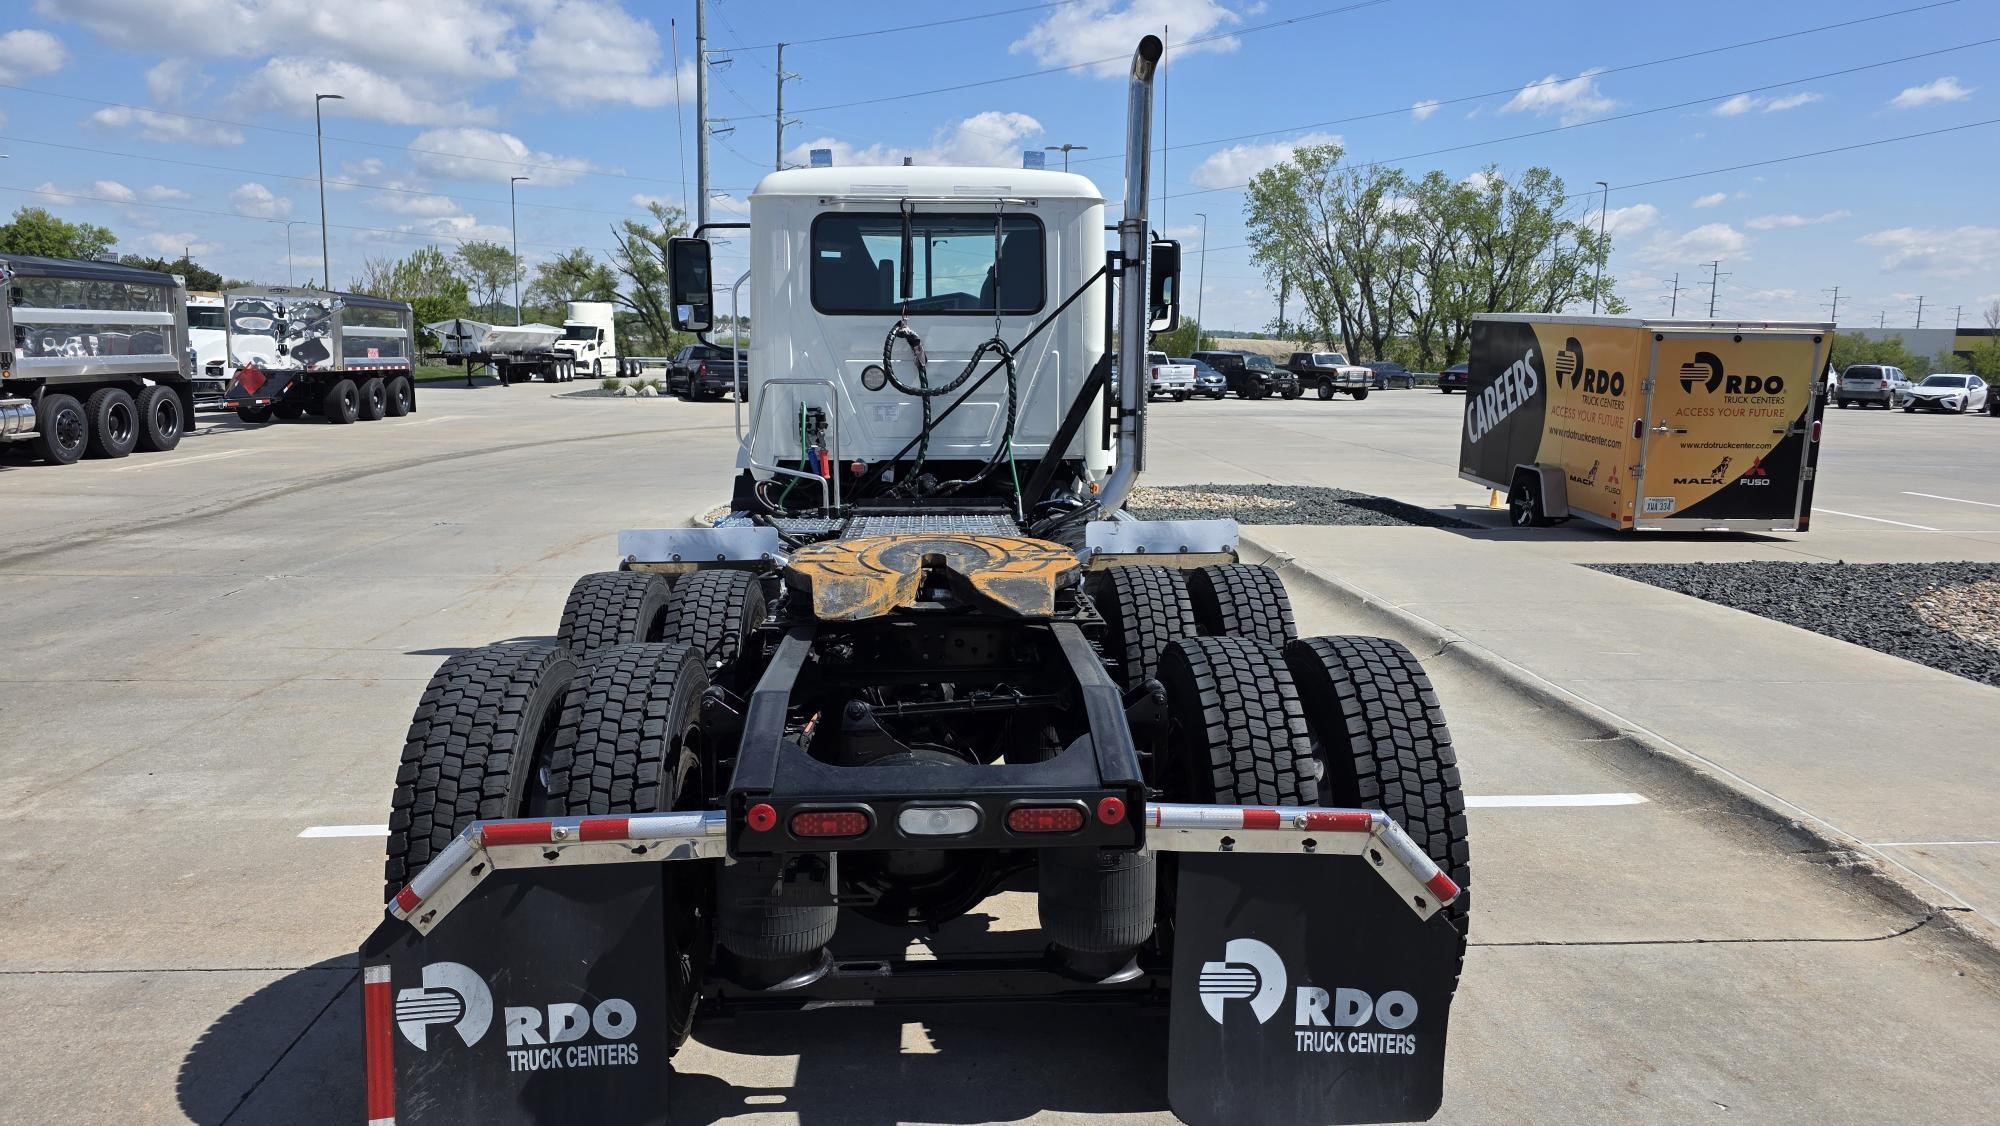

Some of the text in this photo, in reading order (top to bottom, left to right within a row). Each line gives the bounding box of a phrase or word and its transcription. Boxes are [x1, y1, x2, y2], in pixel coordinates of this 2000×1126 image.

[1583, 368, 1624, 397] RDO
[1725, 375, 1784, 394] RDO
[1467, 348, 1538, 443] CAREERS
[1582, 394, 1625, 411] TRUCK CENTERS
[1724, 395, 1785, 405] TRUCK CENTERS
[1551, 405, 1624, 429] ACCESS YOUR FUTURE
[1675, 407, 1785, 418] ACCESS YOUR FUTURE
[1549, 426, 1622, 449] www.rdotruckcenter.com
[1680, 442, 1772, 450] www.rdotruckcenter.com
[1569, 475, 1594, 487] MACK
[1604, 485, 1621, 495] FUSO
[1740, 478, 1770, 486] FUSO
[1295, 986, 1418, 1030] RDO
[504, 998, 637, 1046] RDO
[1295, 1031, 1416, 1055] TRUCK CENTERS
[507, 1042, 639, 1072] TRUCK CENTERS
